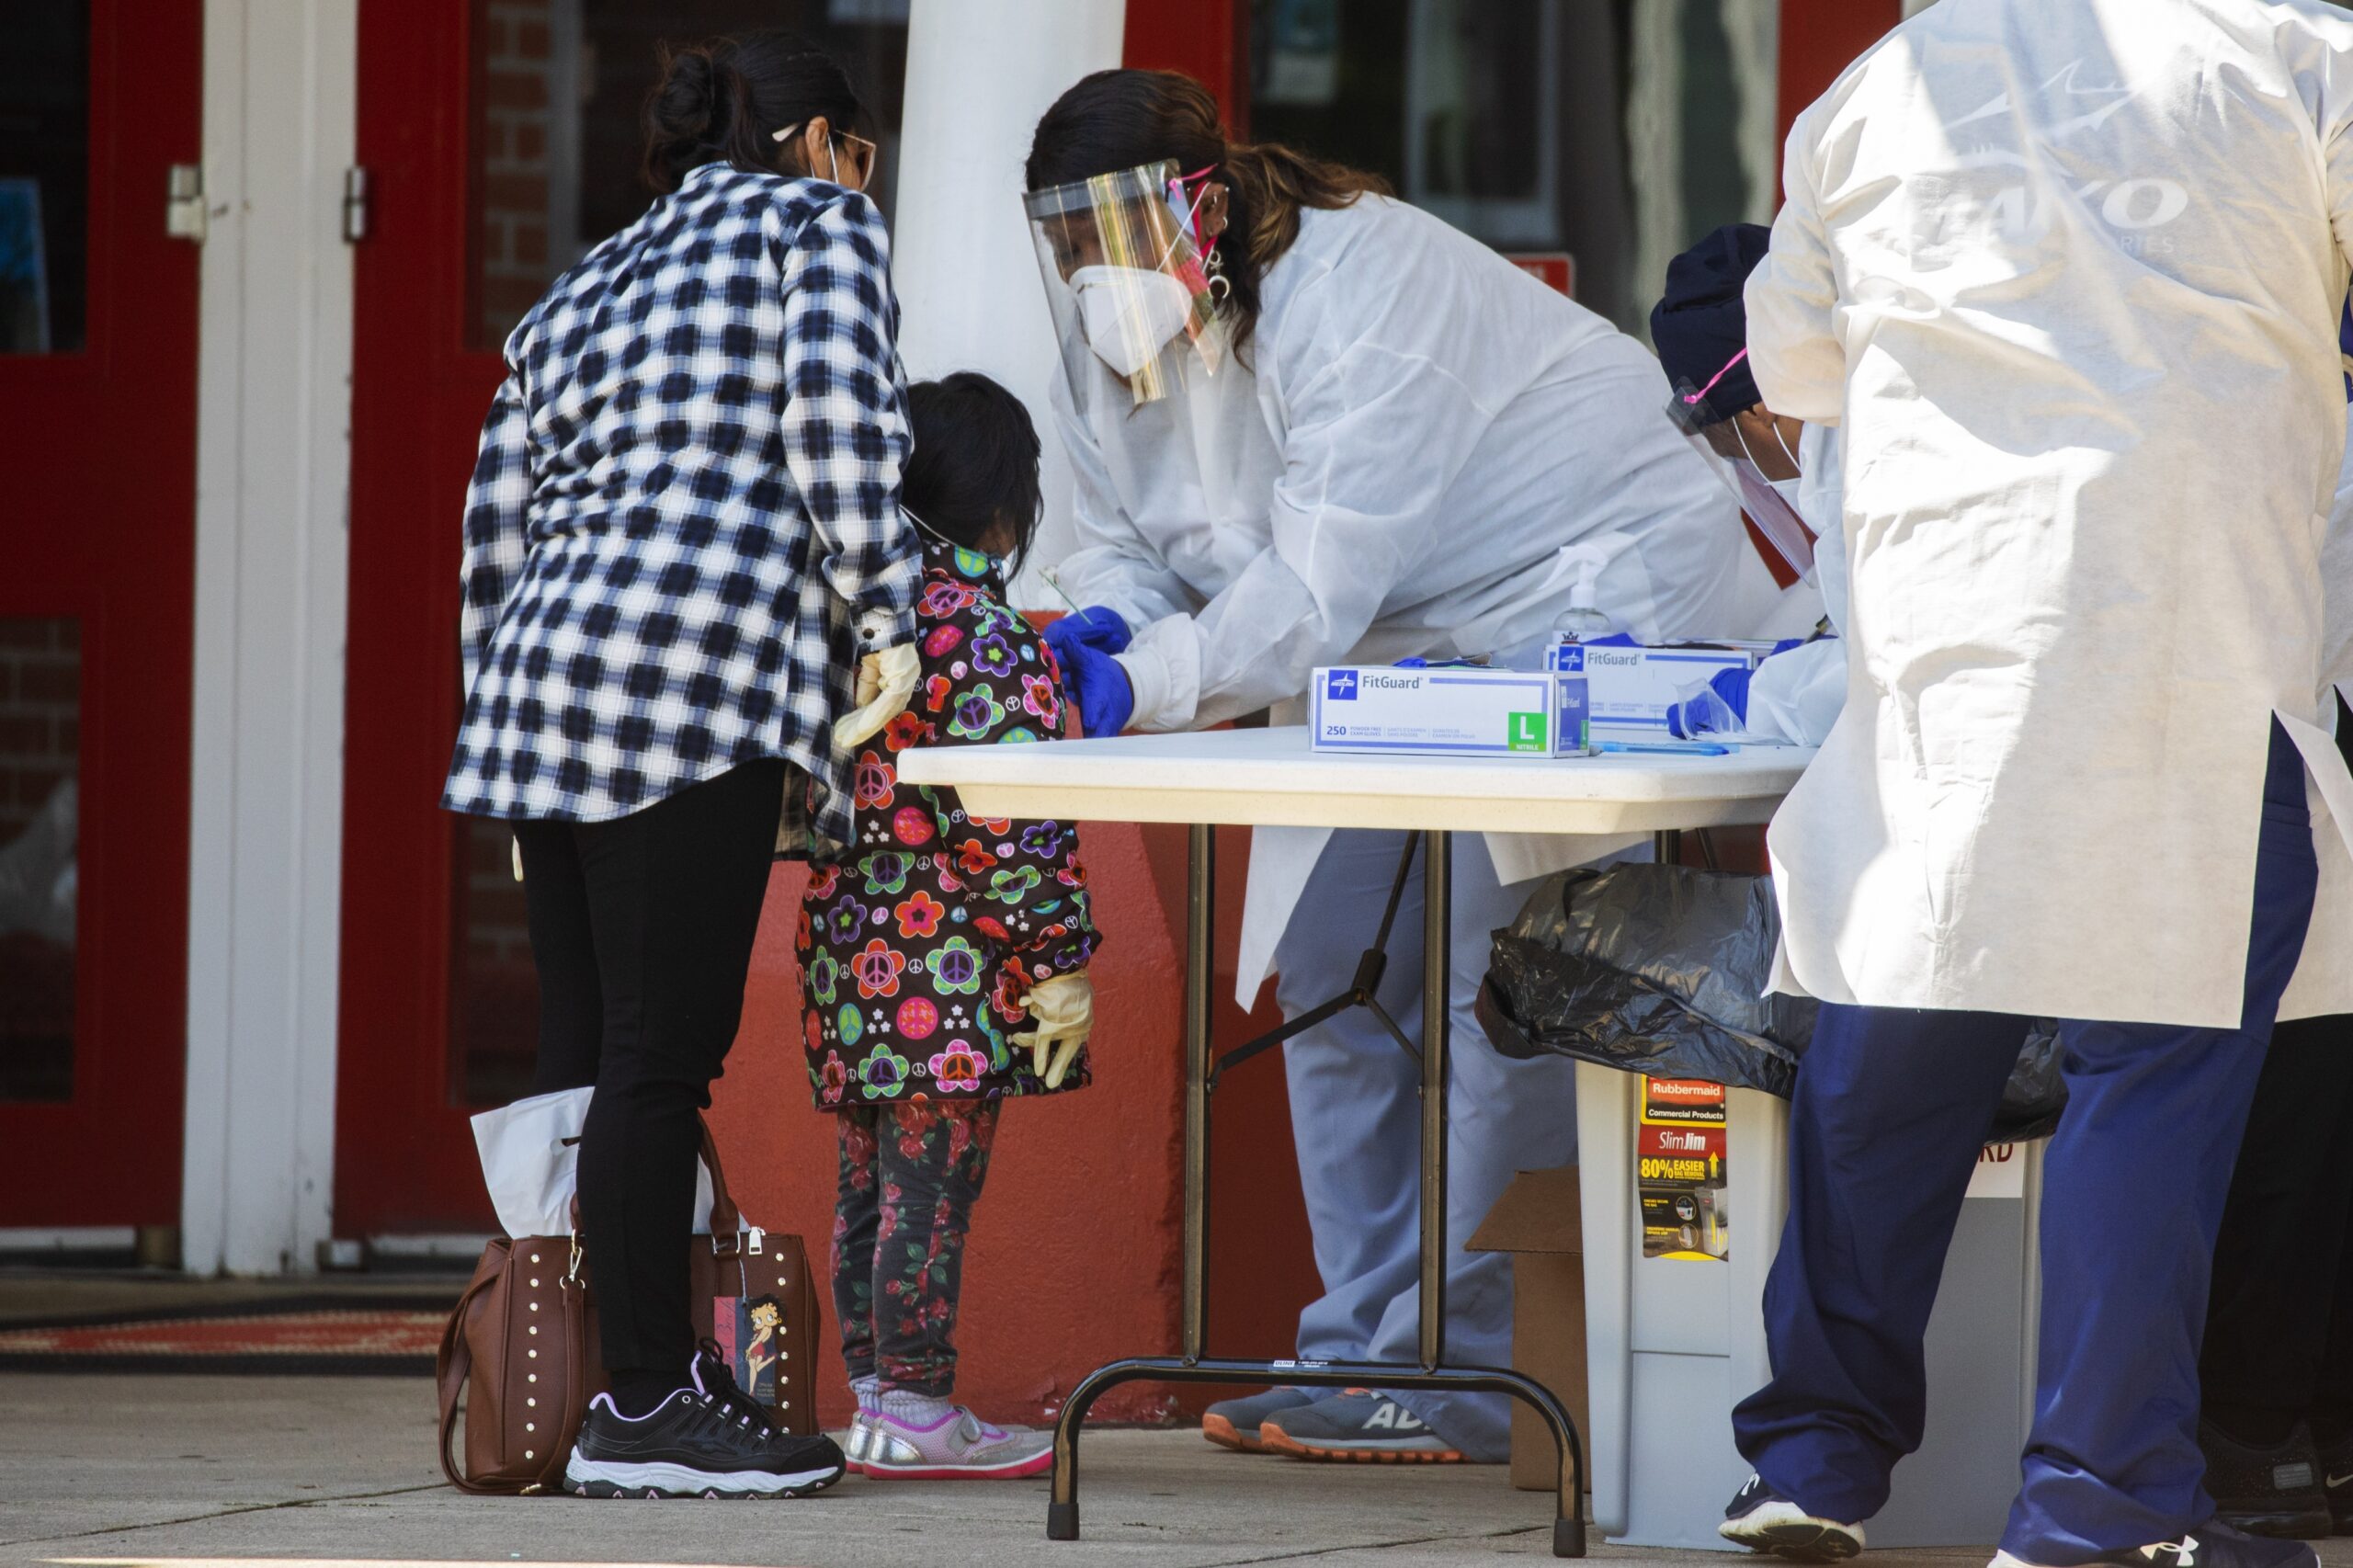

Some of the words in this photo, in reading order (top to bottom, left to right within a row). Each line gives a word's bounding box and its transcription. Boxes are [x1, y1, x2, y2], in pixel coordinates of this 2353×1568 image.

[1587, 653, 1638, 665] FitGuard
[1362, 676, 1420, 689] FitGuard
[1326, 726, 1347, 735] 250
[1520, 716, 1535, 739] L
[1653, 1083, 1721, 1096] Rubbermaid
[1648, 1108, 1690, 1119] Commercial
[1692, 1110, 1724, 1119] Products
[1641, 1158, 1674, 1178] 80%
[1674, 1159, 1705, 1172] EASIER
[1361, 1403, 1430, 1430] AD
